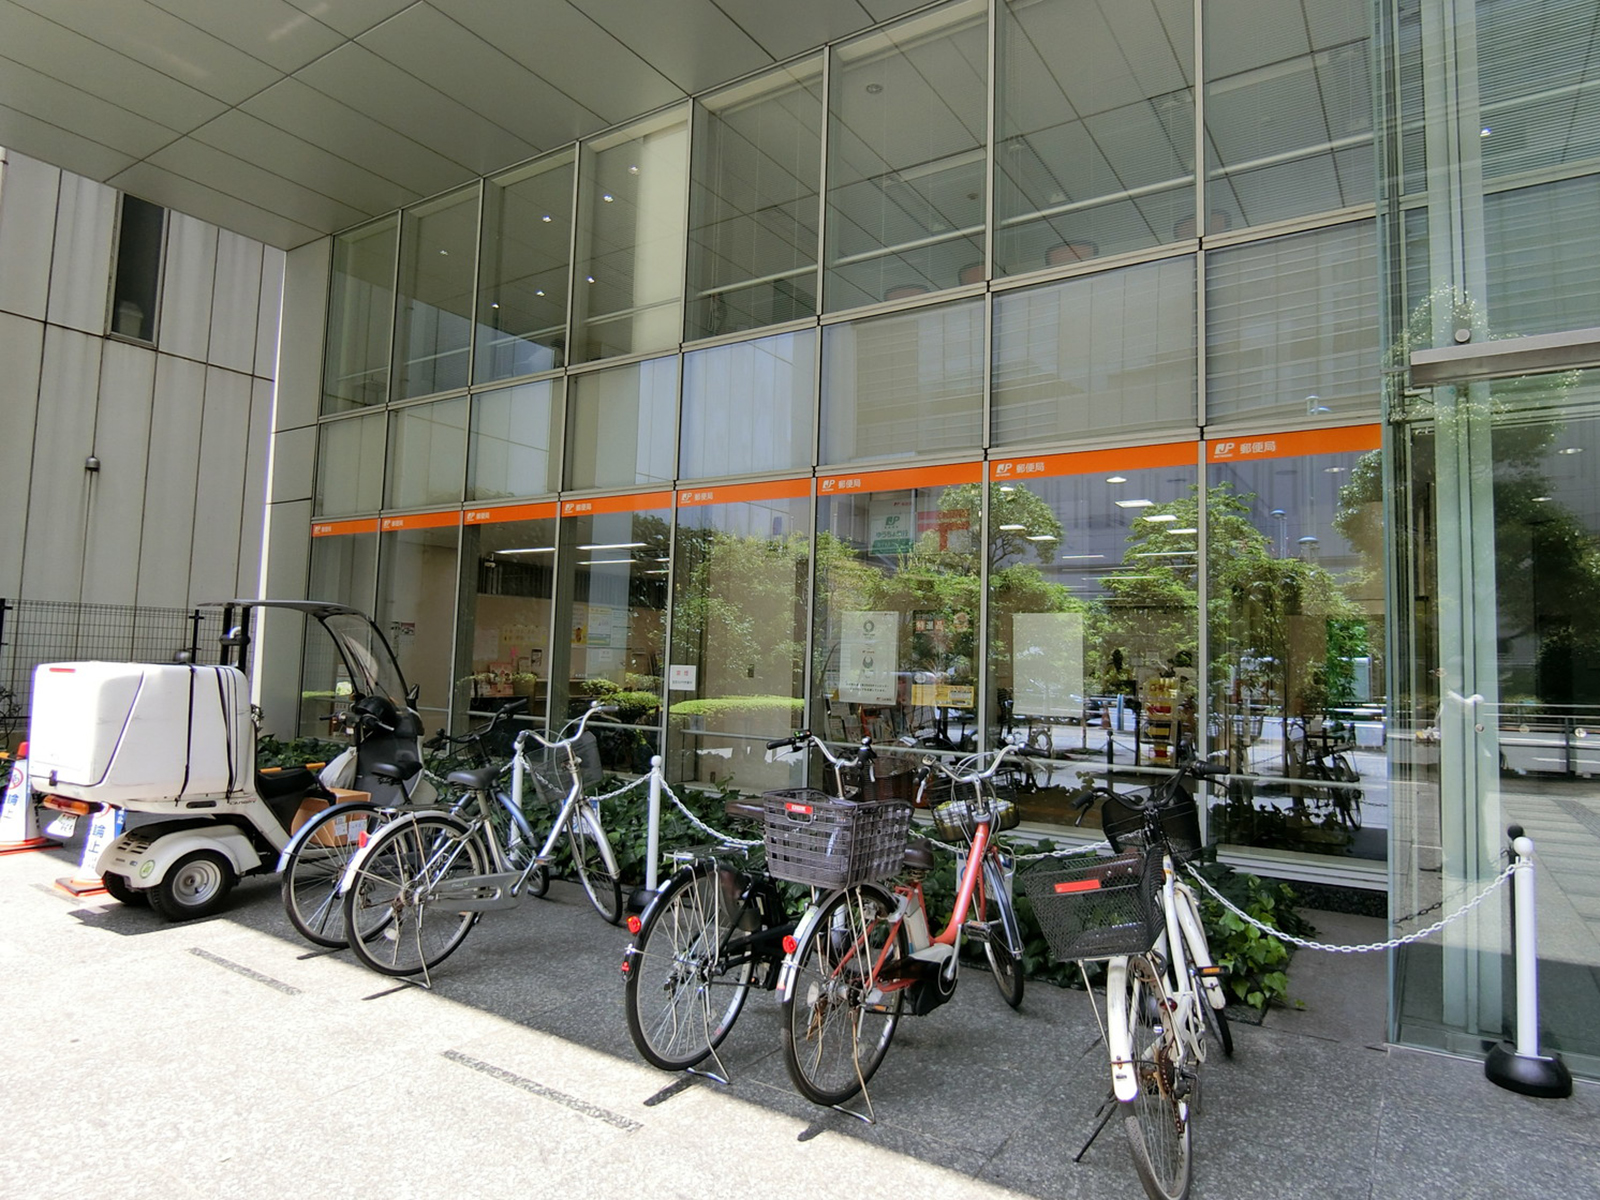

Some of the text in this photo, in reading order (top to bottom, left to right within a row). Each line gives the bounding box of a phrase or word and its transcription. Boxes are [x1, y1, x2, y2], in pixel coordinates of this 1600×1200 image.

[1240, 441, 1276, 454] 郵便局
[1016, 462, 1045, 473] 郵便局
